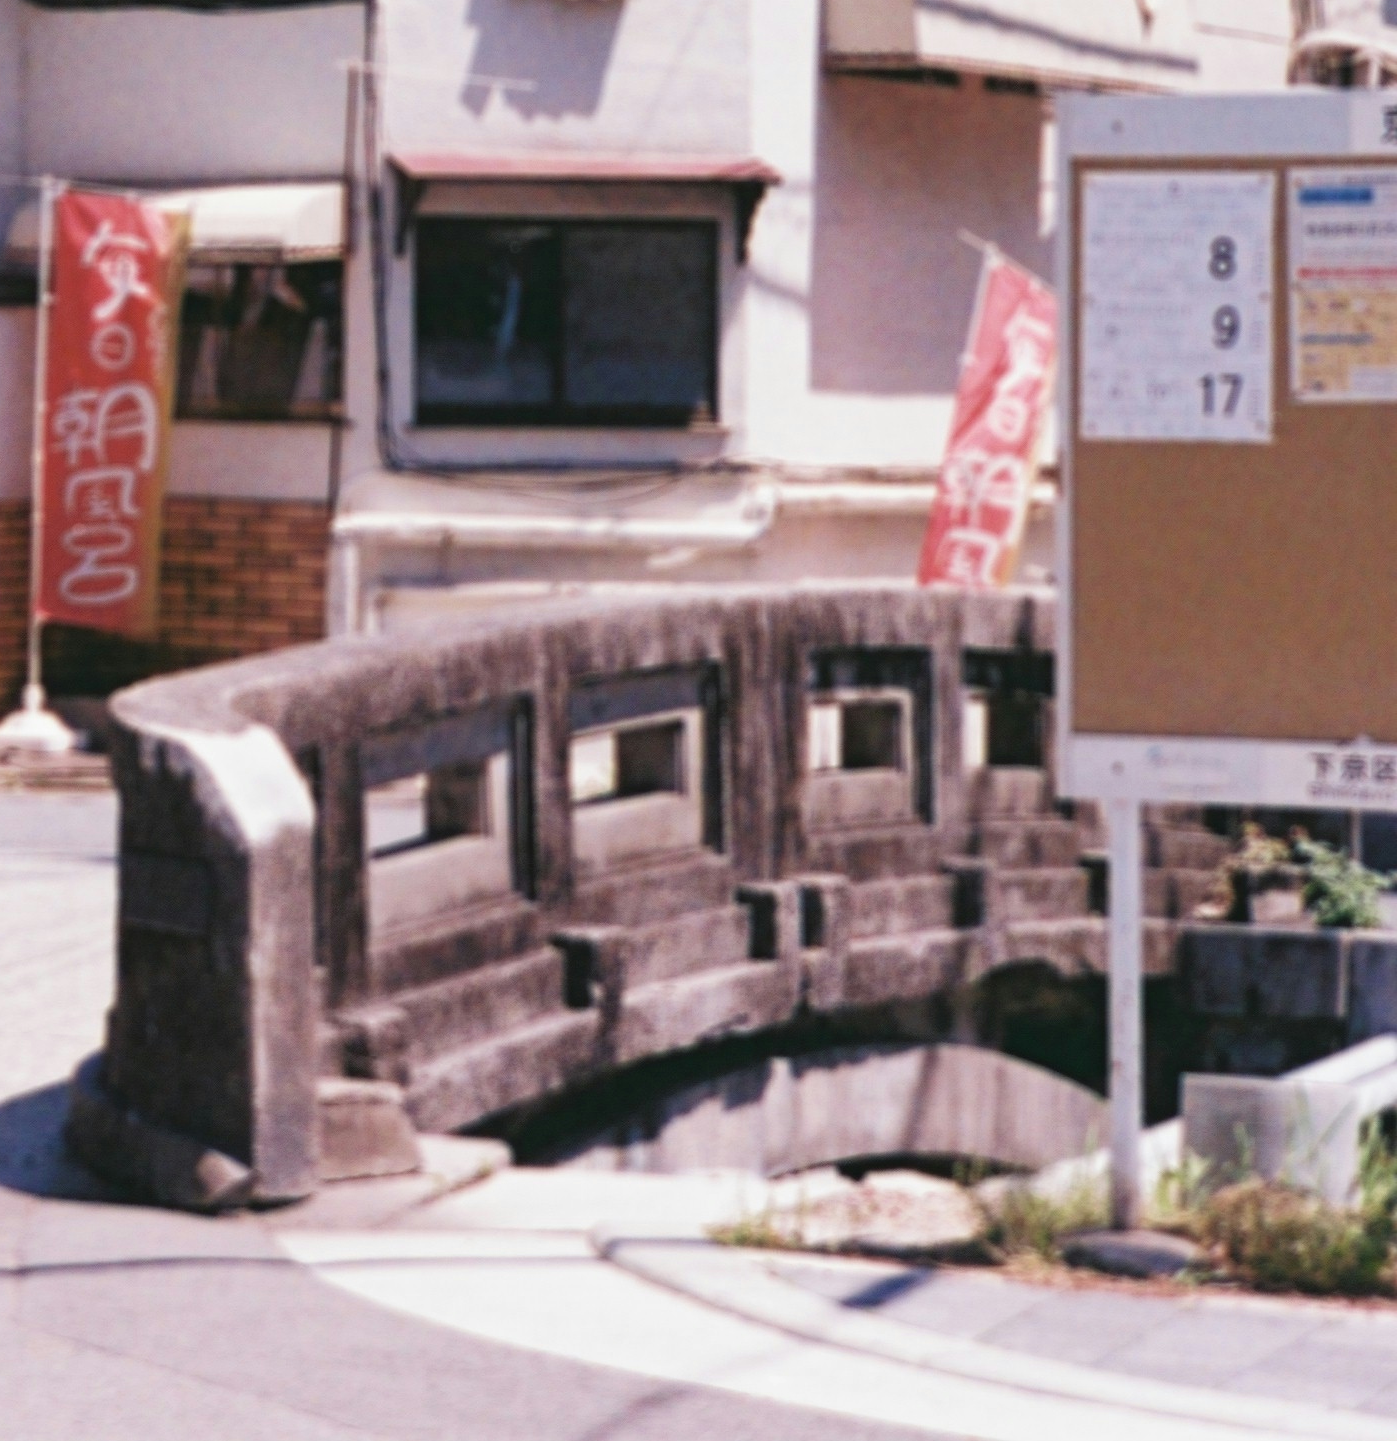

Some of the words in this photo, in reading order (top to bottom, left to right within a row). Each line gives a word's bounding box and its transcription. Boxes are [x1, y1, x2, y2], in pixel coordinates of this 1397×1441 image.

[1208, 234, 1238, 282] 8
[1212, 303, 1242, 350] 9
[1197, 371, 1245, 419] 17
[1307, 750, 1397, 782] 下京区
